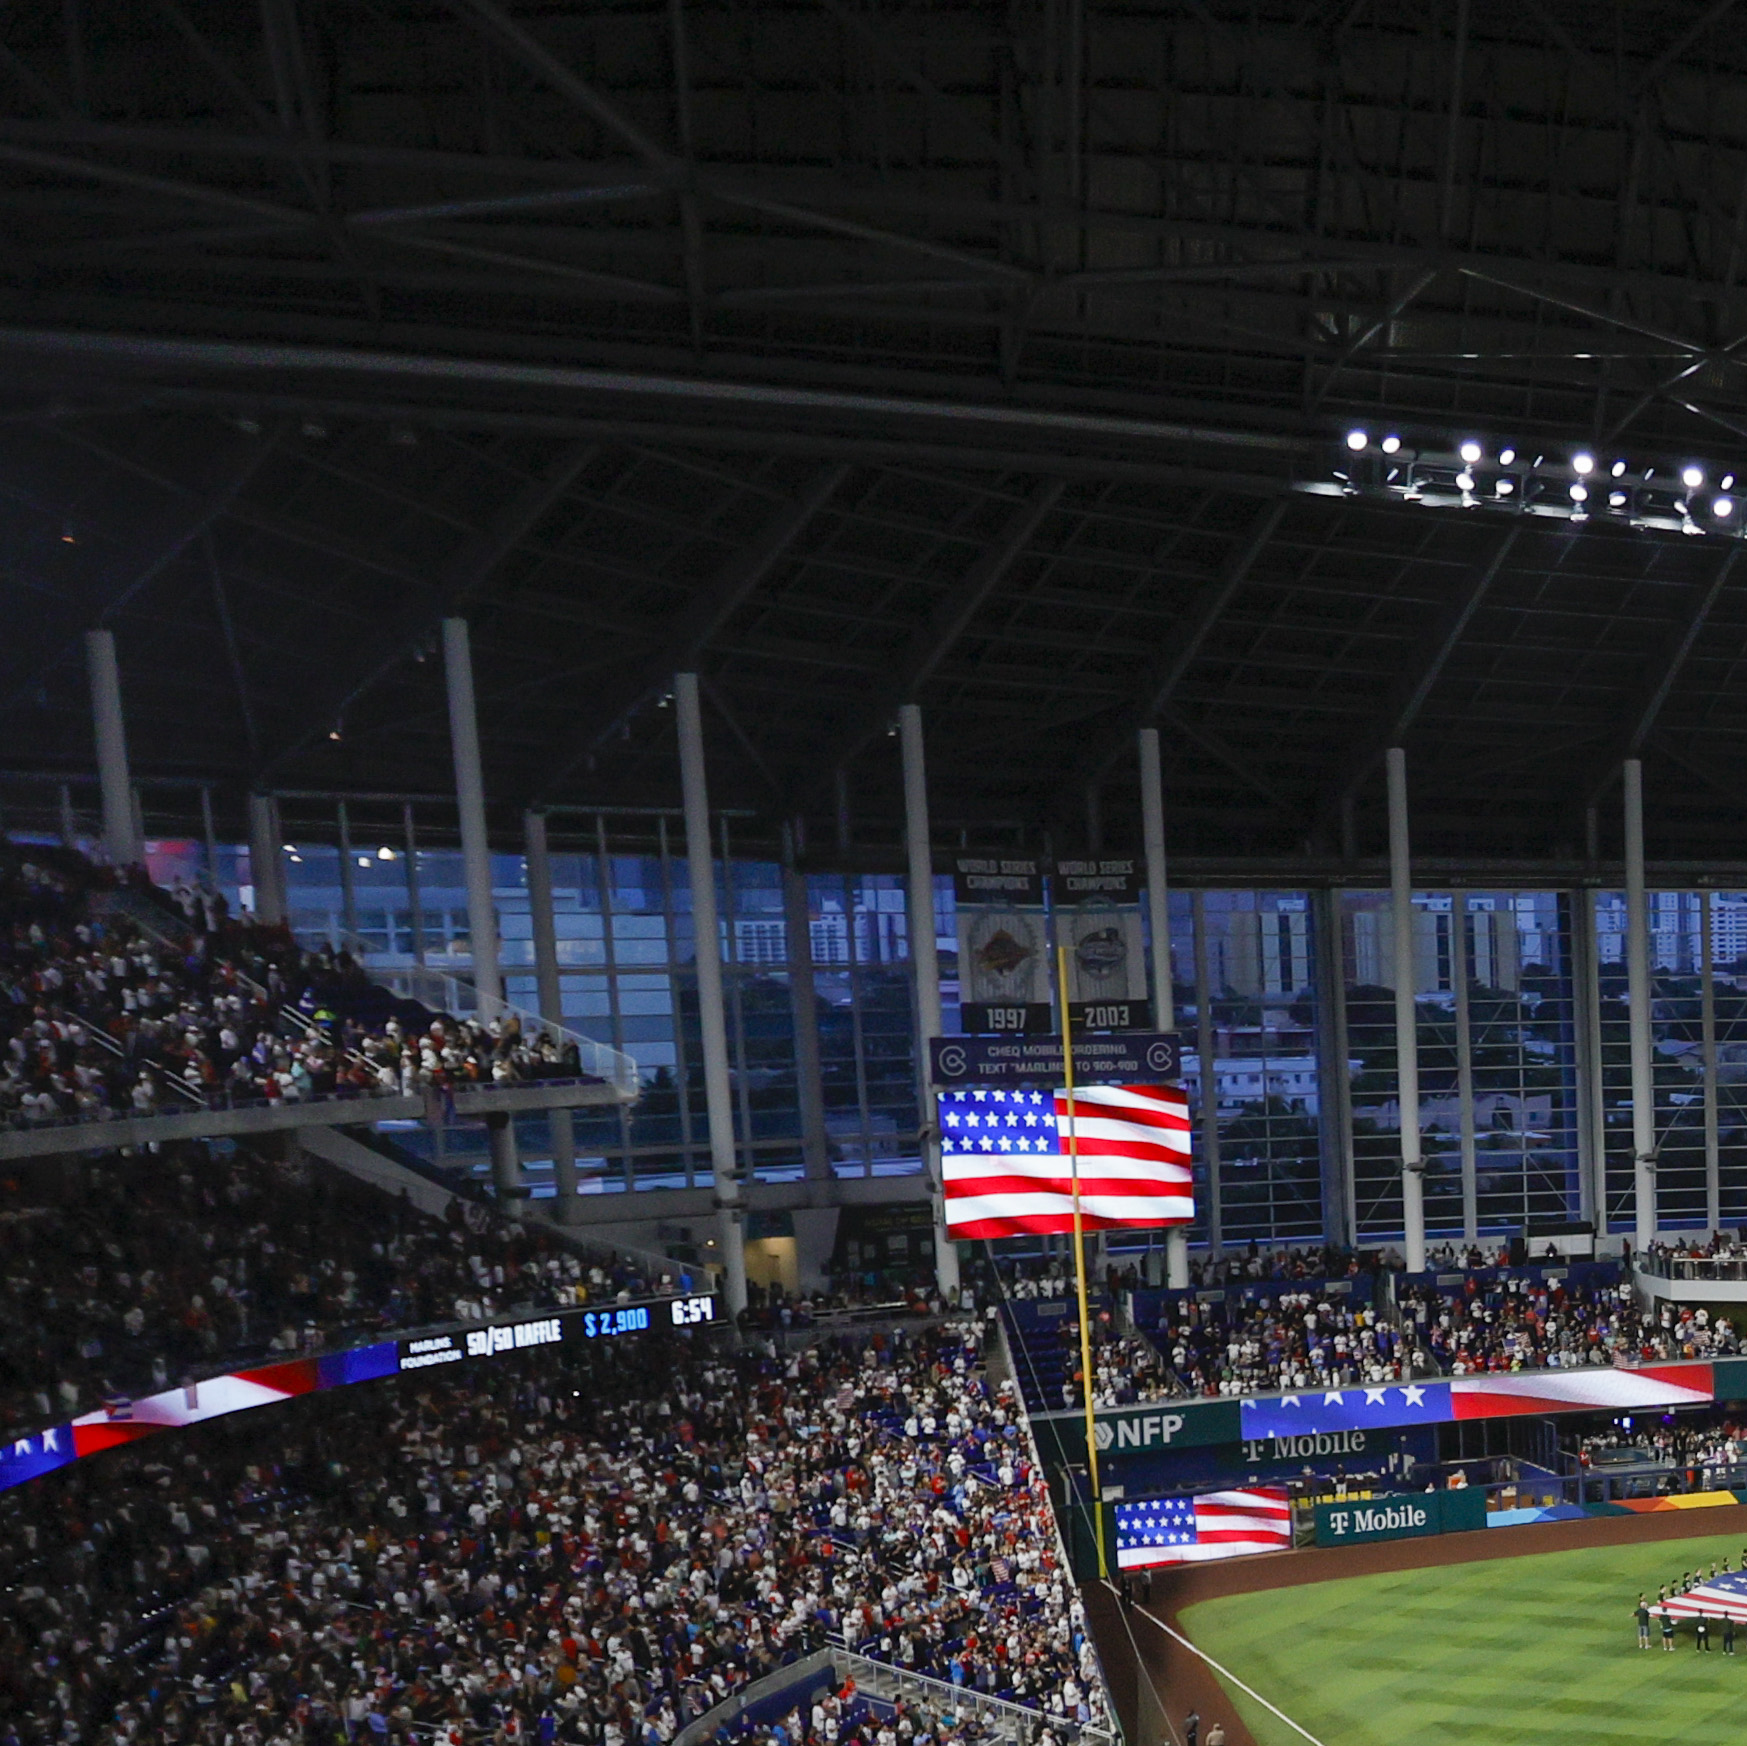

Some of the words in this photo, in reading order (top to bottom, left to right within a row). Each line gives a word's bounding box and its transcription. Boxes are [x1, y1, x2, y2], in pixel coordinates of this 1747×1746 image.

[957, 860, 998, 874] WORLD
[1000, 860, 1036, 874] SERIES
[1057, 860, 1096, 875] WORLD
[1099, 860, 1134, 874] SERIES
[967, 876, 1030, 890] CHAMPIONS
[1067, 876, 1127, 891] CHAMPIONS
[986, 1007, 1027, 1029] 1997
[1084, 1005, 1130, 1027] 2003
[977, 1062, 1008, 1074] TEXT
[1074, 1061, 1090, 1073] TO
[671, 1297, 713, 1325] 6:54
[600, 1308, 648, 1336] 2,900
[409, 1336, 453, 1354] MARLINS
[466, 1326, 515, 1357] 50/50
[515, 1319, 562, 1348] RAFFLE
[400, 1349, 463, 1370] FOUNDATION
[1117, 1415, 1183, 1448] NFP
